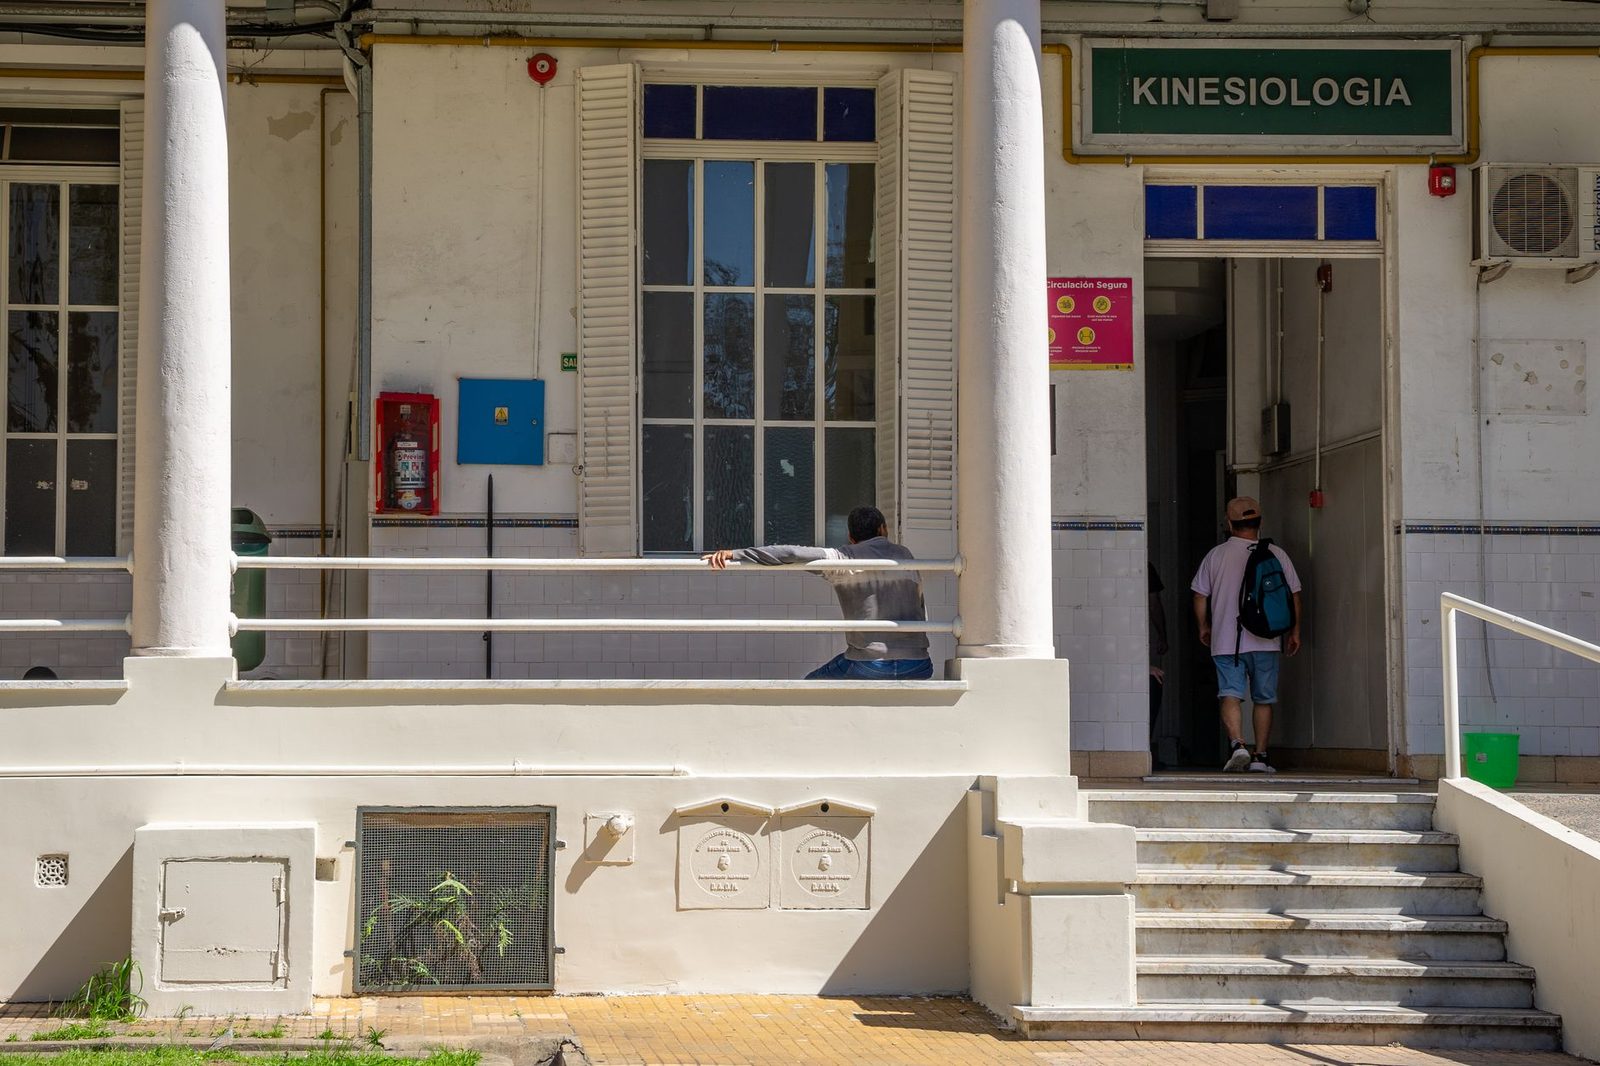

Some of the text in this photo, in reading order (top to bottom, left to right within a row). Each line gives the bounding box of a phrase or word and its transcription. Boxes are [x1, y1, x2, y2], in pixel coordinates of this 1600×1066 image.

[1132, 76, 1412, 106] KINESIOLOGIA
[1047, 281, 1128, 290] Circulación Segura
